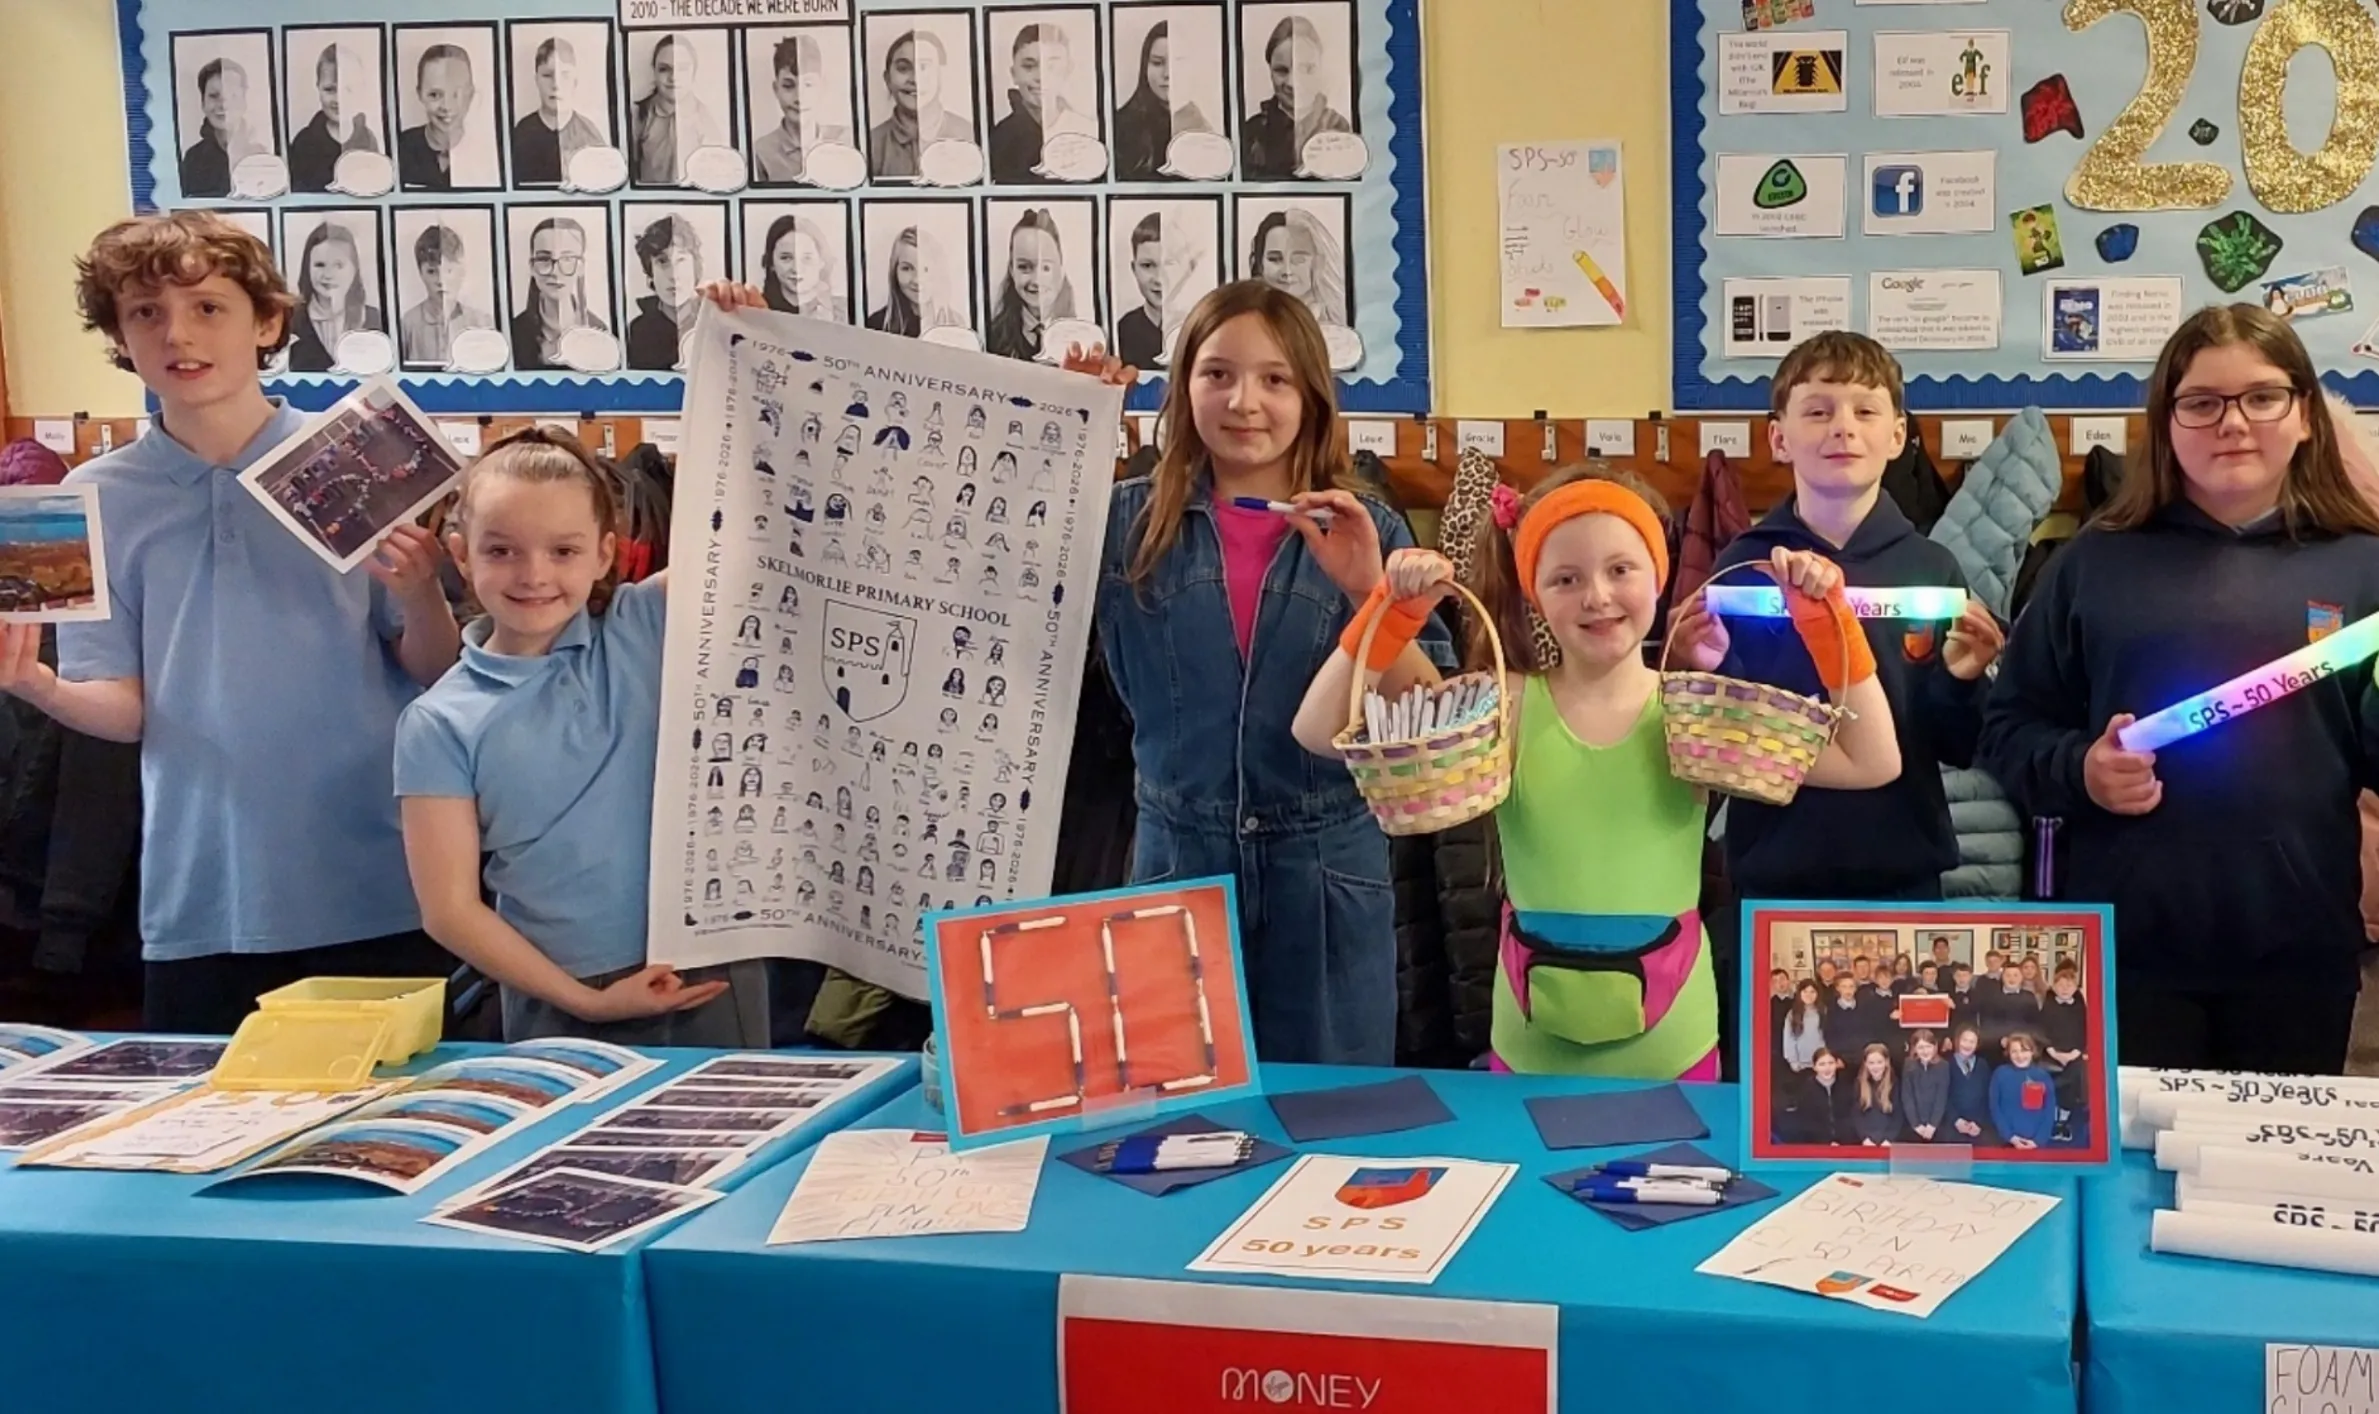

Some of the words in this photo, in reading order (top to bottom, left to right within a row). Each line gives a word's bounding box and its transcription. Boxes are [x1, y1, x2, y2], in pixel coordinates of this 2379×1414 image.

[669, 0, 692, 17] THE
[746, 0, 763, 15] WE
[767, 0, 800, 14] WERE
[1881, 276, 1925, 292] Google
[751, 338, 786, 358] 1976
[863, 365, 1008, 405] ANNIVERSARY
[1038, 402, 1073, 418] 2026
[2086, 430, 2112, 440] Eden
[697, 539, 723, 679] ANNIVERSARY
[757, 555, 851, 594] SKELMORLIE
[856, 584, 935, 612] PRIMARY
[938, 601, 1012, 627] SCHOOL
[1852, 600, 1902, 617] Years
[831, 626, 881, 657] SPS
[1021, 648, 1054, 786] ANNIVERSARY
[2189, 700, 2231, 732] SPS
[2245, 683, 2272, 708] 50
[2272, 660, 2335, 693] Years
[803, 912, 921, 961] ANNIVERSARY
[2159, 1076, 2206, 1093] SPS
[1799, 1188, 1997, 1244] BIRTHDAY
[1241, 1238, 1294, 1254] 50
[1298, 1243, 1422, 1260] years
[1221, 1367, 1382, 1409] MONEY
[2276, 1344, 2375, 1403] FOAM
